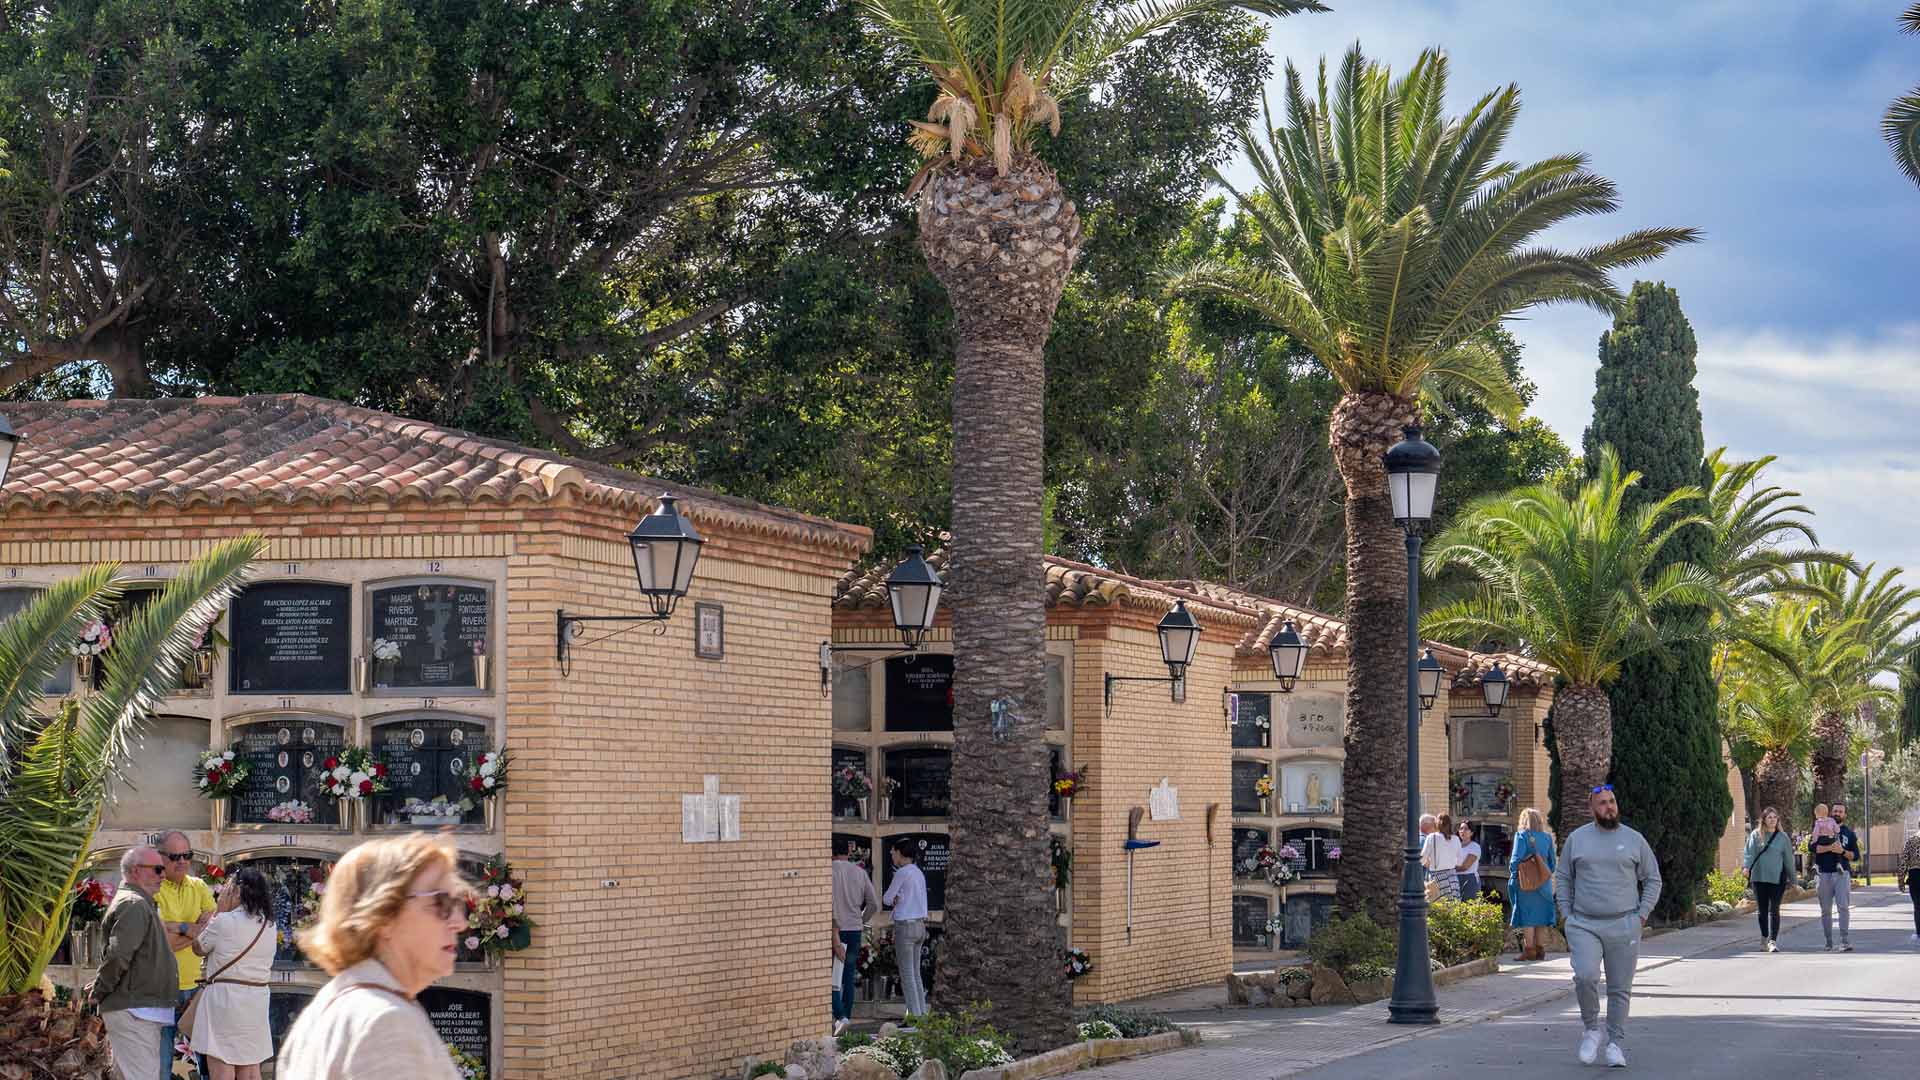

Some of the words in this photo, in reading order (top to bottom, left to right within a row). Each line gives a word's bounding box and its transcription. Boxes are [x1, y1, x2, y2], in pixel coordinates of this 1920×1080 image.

[145, 566, 156, 576] 10
[288, 564, 297, 574] 11
[429, 562, 441, 573] 12
[388, 606, 415, 615] RIVERO
[384, 617, 419, 626] MARTINEZ
[282, 699, 291, 709] 11
[424, 699, 434, 709] 12
[283, 835, 293, 846] 11
[282, 972, 291, 982] 11
[430, 1011, 458, 1019] NAVARRO
[458, 1011, 481, 1019] ALBERT
